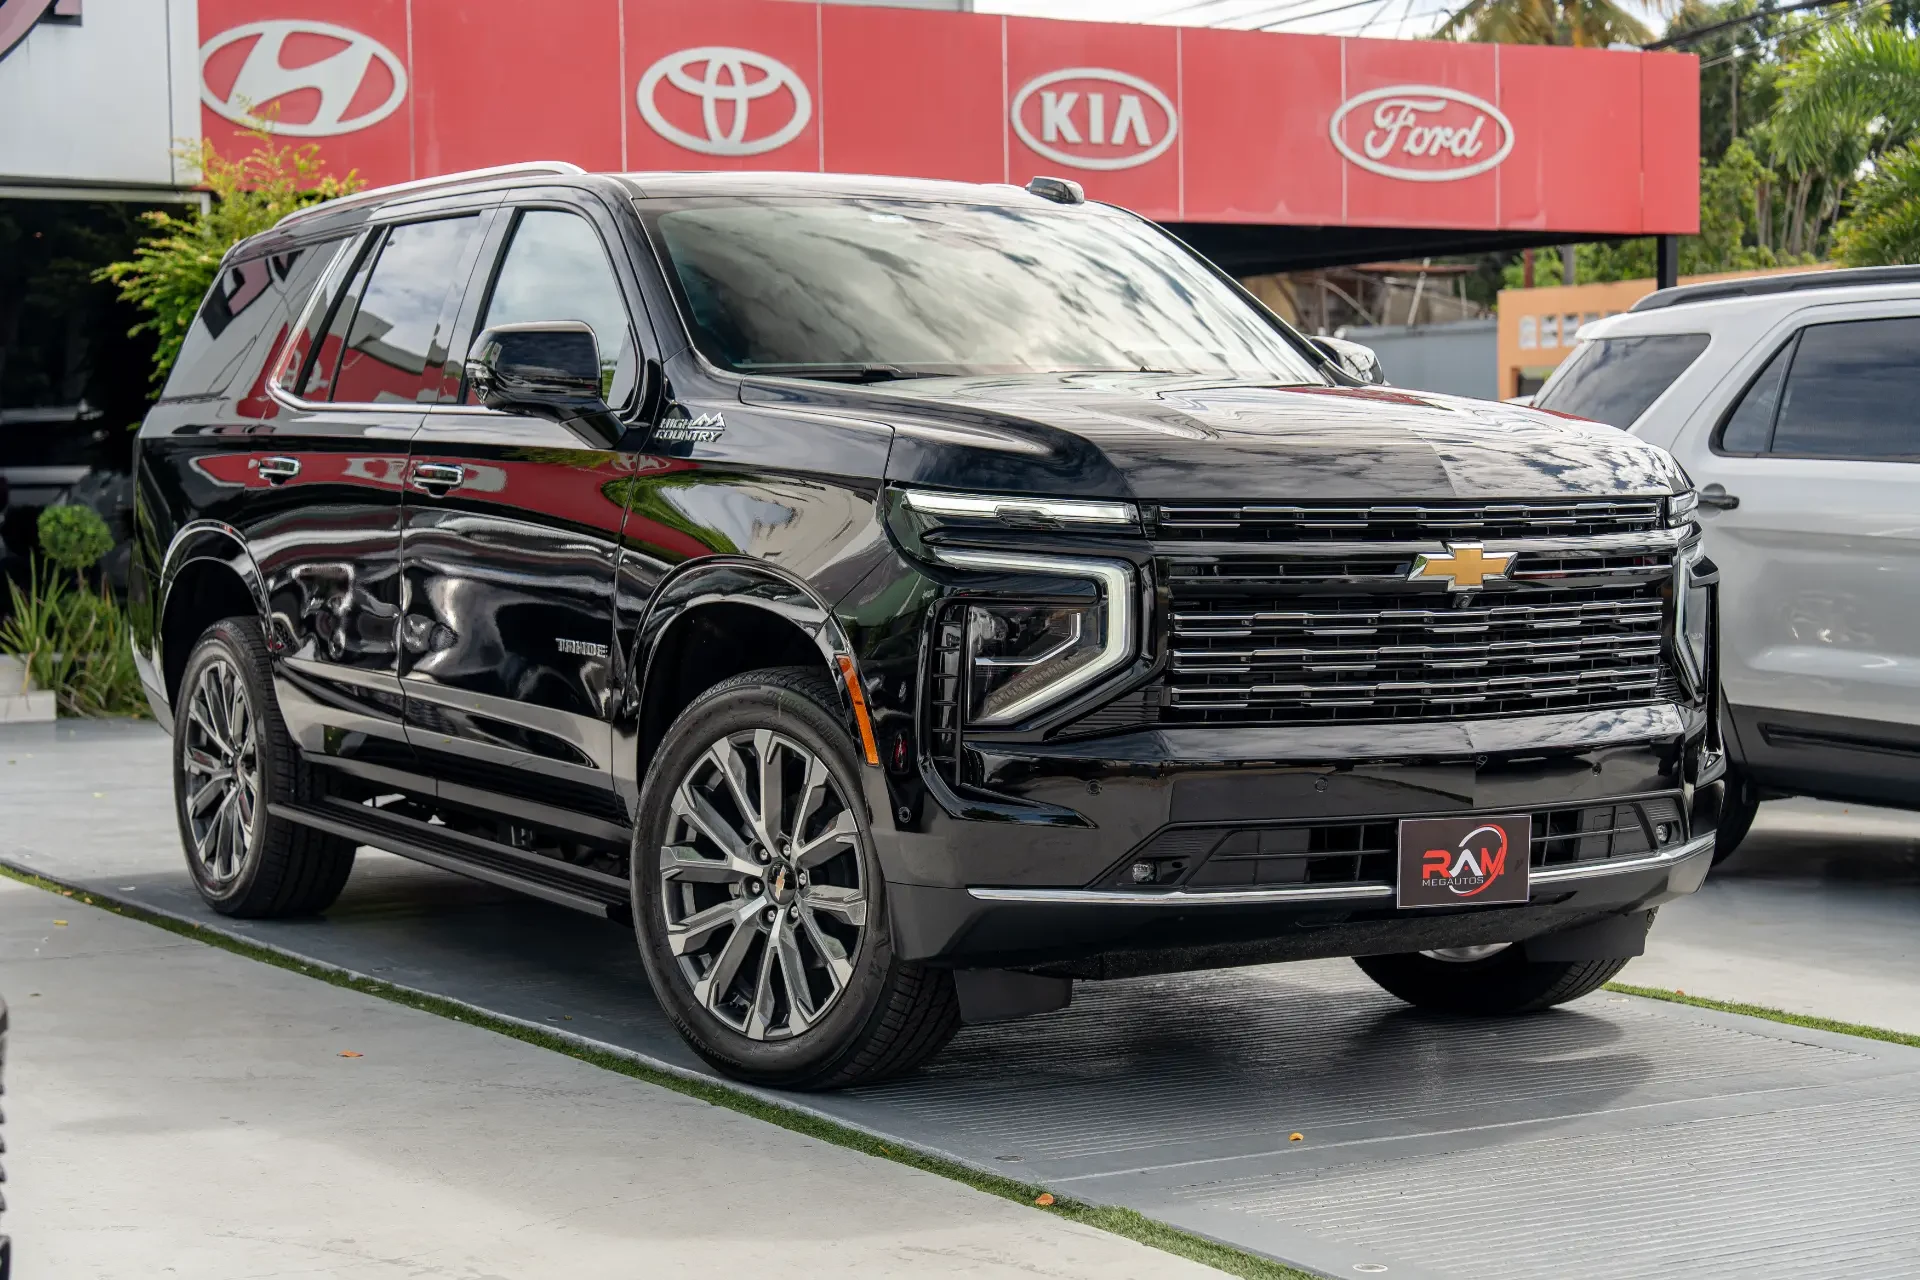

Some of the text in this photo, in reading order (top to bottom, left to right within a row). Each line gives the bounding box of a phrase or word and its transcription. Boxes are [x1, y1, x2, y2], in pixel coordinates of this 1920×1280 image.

[1041, 91, 1153, 147] KIA
[1363, 99, 1486, 161] Ford
[659, 418, 693, 429] HIGH
[654, 429, 722, 442] COUNTRY
[555, 637, 608, 658] TAHOE
[1422, 848, 1505, 879] RAM
[1422, 876, 1484, 887] MEGAUTOS
